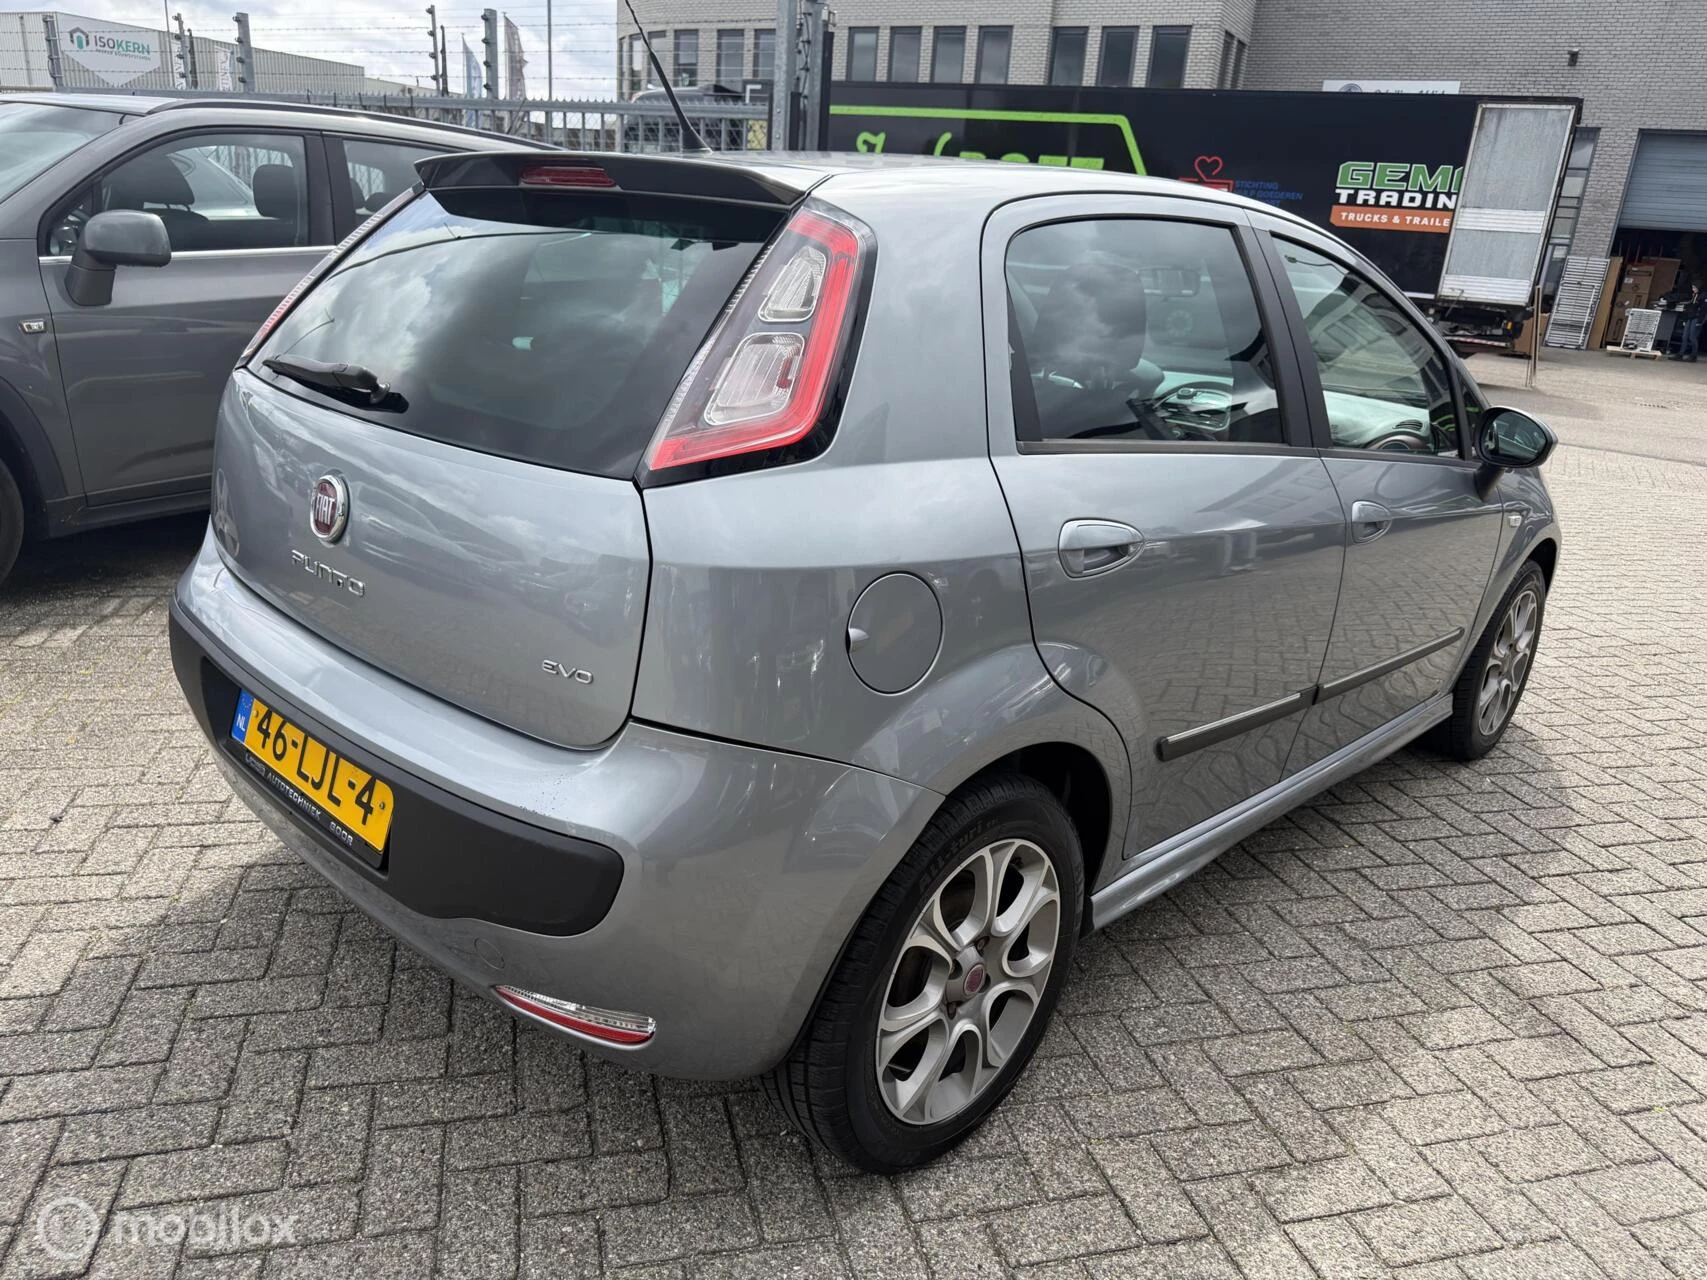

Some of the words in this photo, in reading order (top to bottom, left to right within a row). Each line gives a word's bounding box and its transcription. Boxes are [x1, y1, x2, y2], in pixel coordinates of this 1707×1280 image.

[94, 35, 150, 55] ISOKERN
[1340, 212, 1388, 224] TRUCKS
[1392, 216, 1400, 224] &
[315, 492, 336, 526] FIAT
[291, 549, 366, 597] PUNTO
[541, 659, 594, 685] EVO
[236, 713, 246, 732] NL
[257, 708, 374, 827] 46-LJL-4
[266, 769, 322, 821] AUTOTECHNIEK
